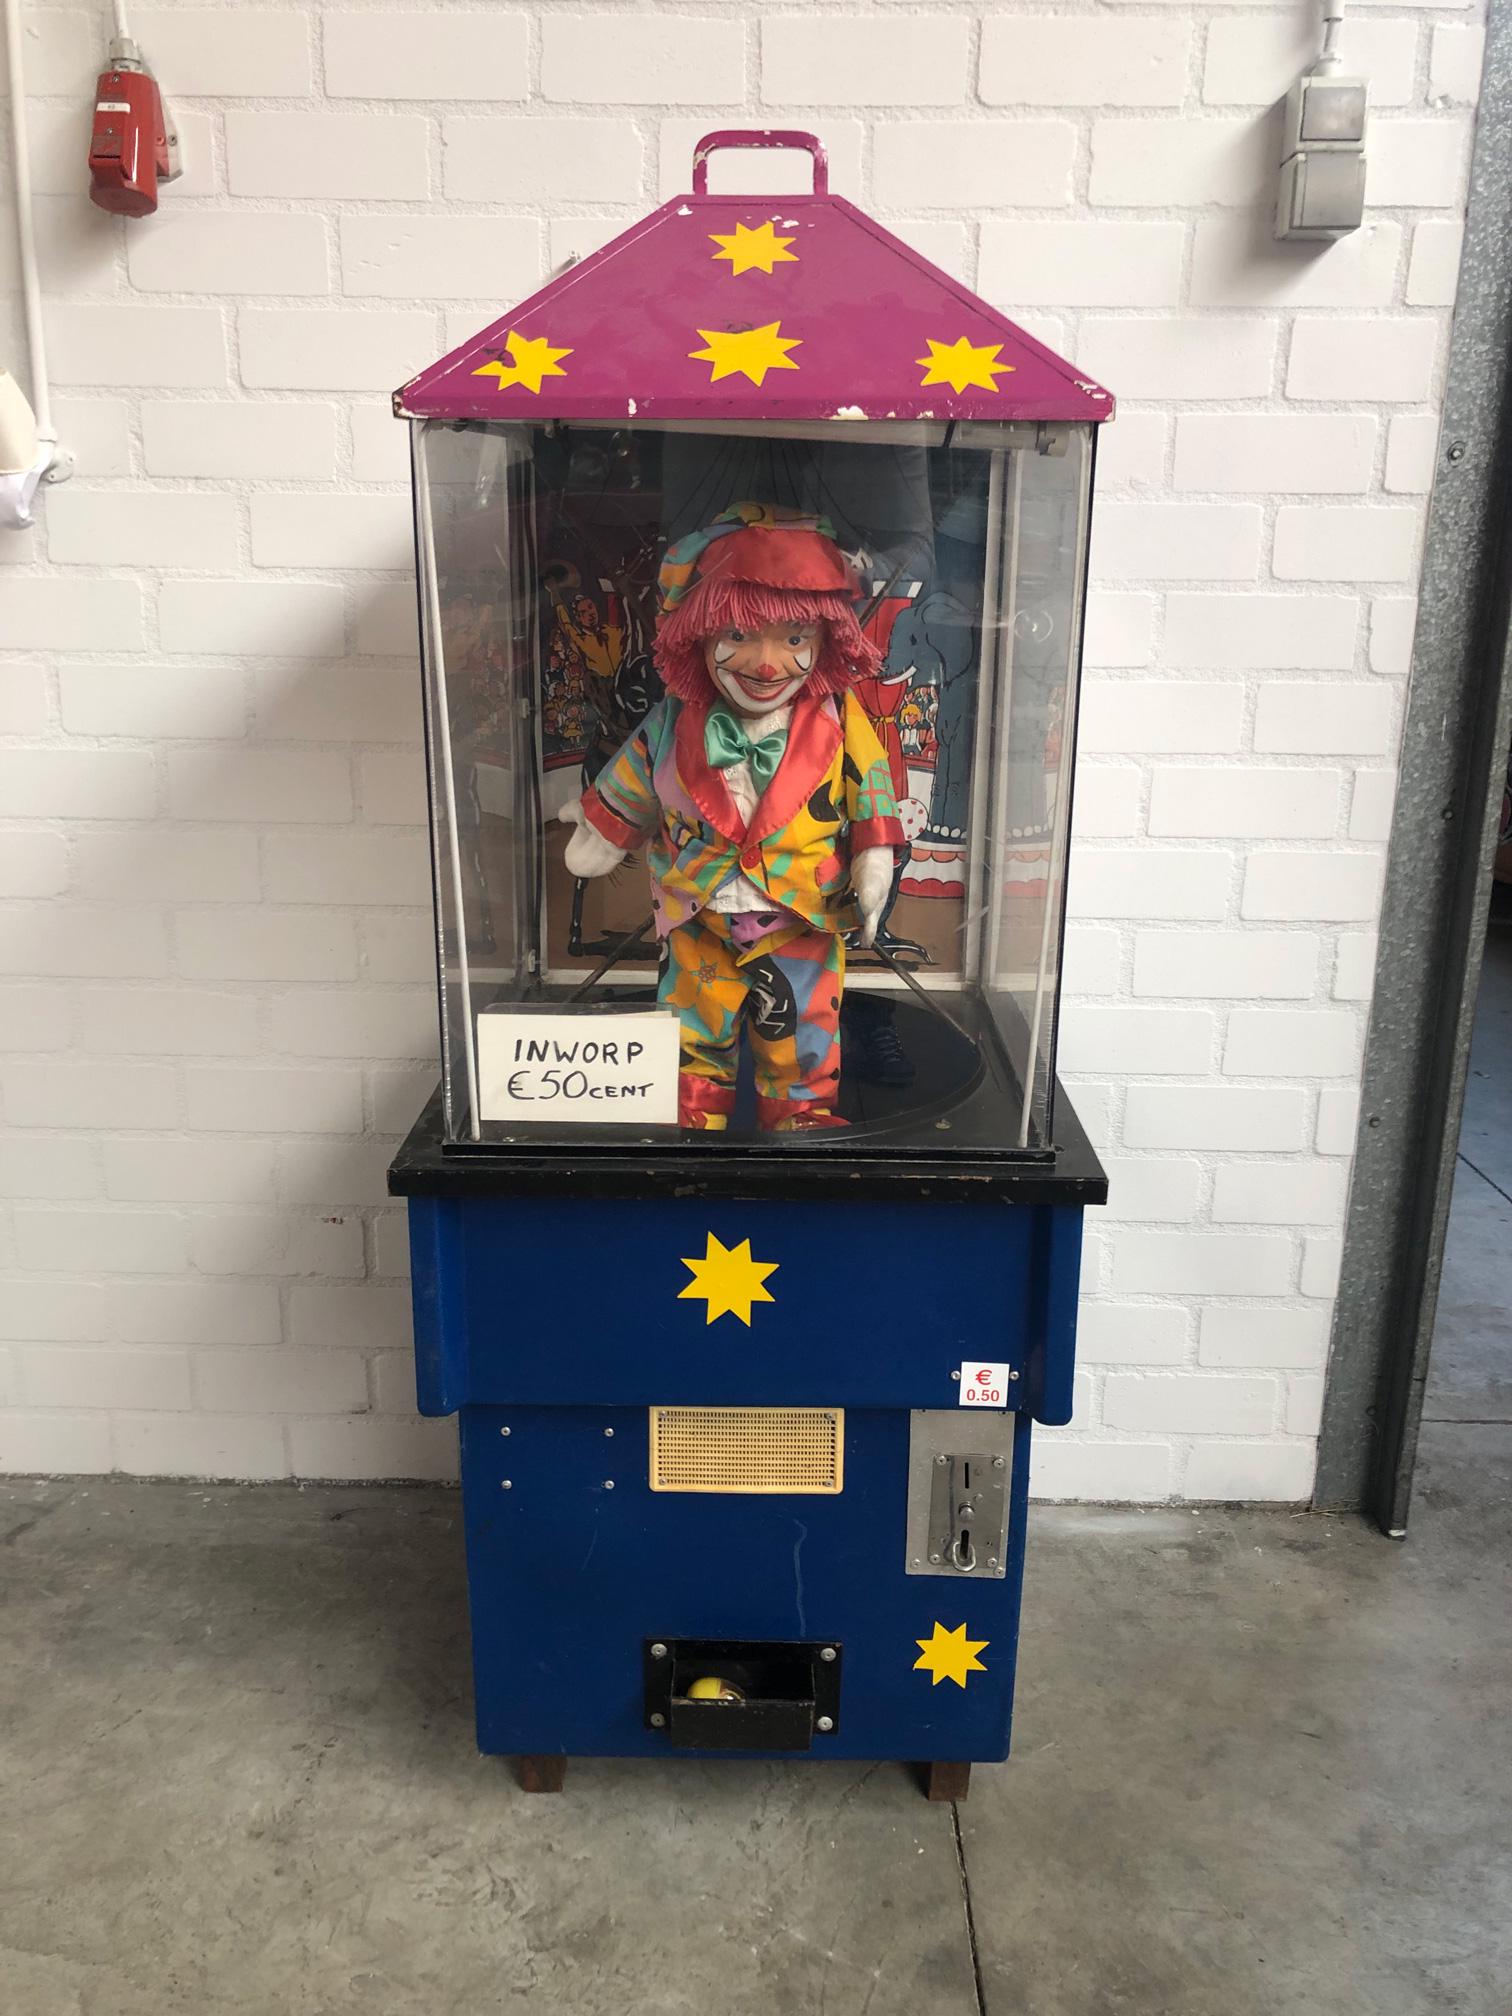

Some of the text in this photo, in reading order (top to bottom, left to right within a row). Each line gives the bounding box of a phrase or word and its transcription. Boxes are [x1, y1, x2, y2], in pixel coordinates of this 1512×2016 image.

[514, 1039, 644, 1065] INWORP
[975, 1369, 993, 1386] €
[966, 1388, 1000, 1402] 0.50
